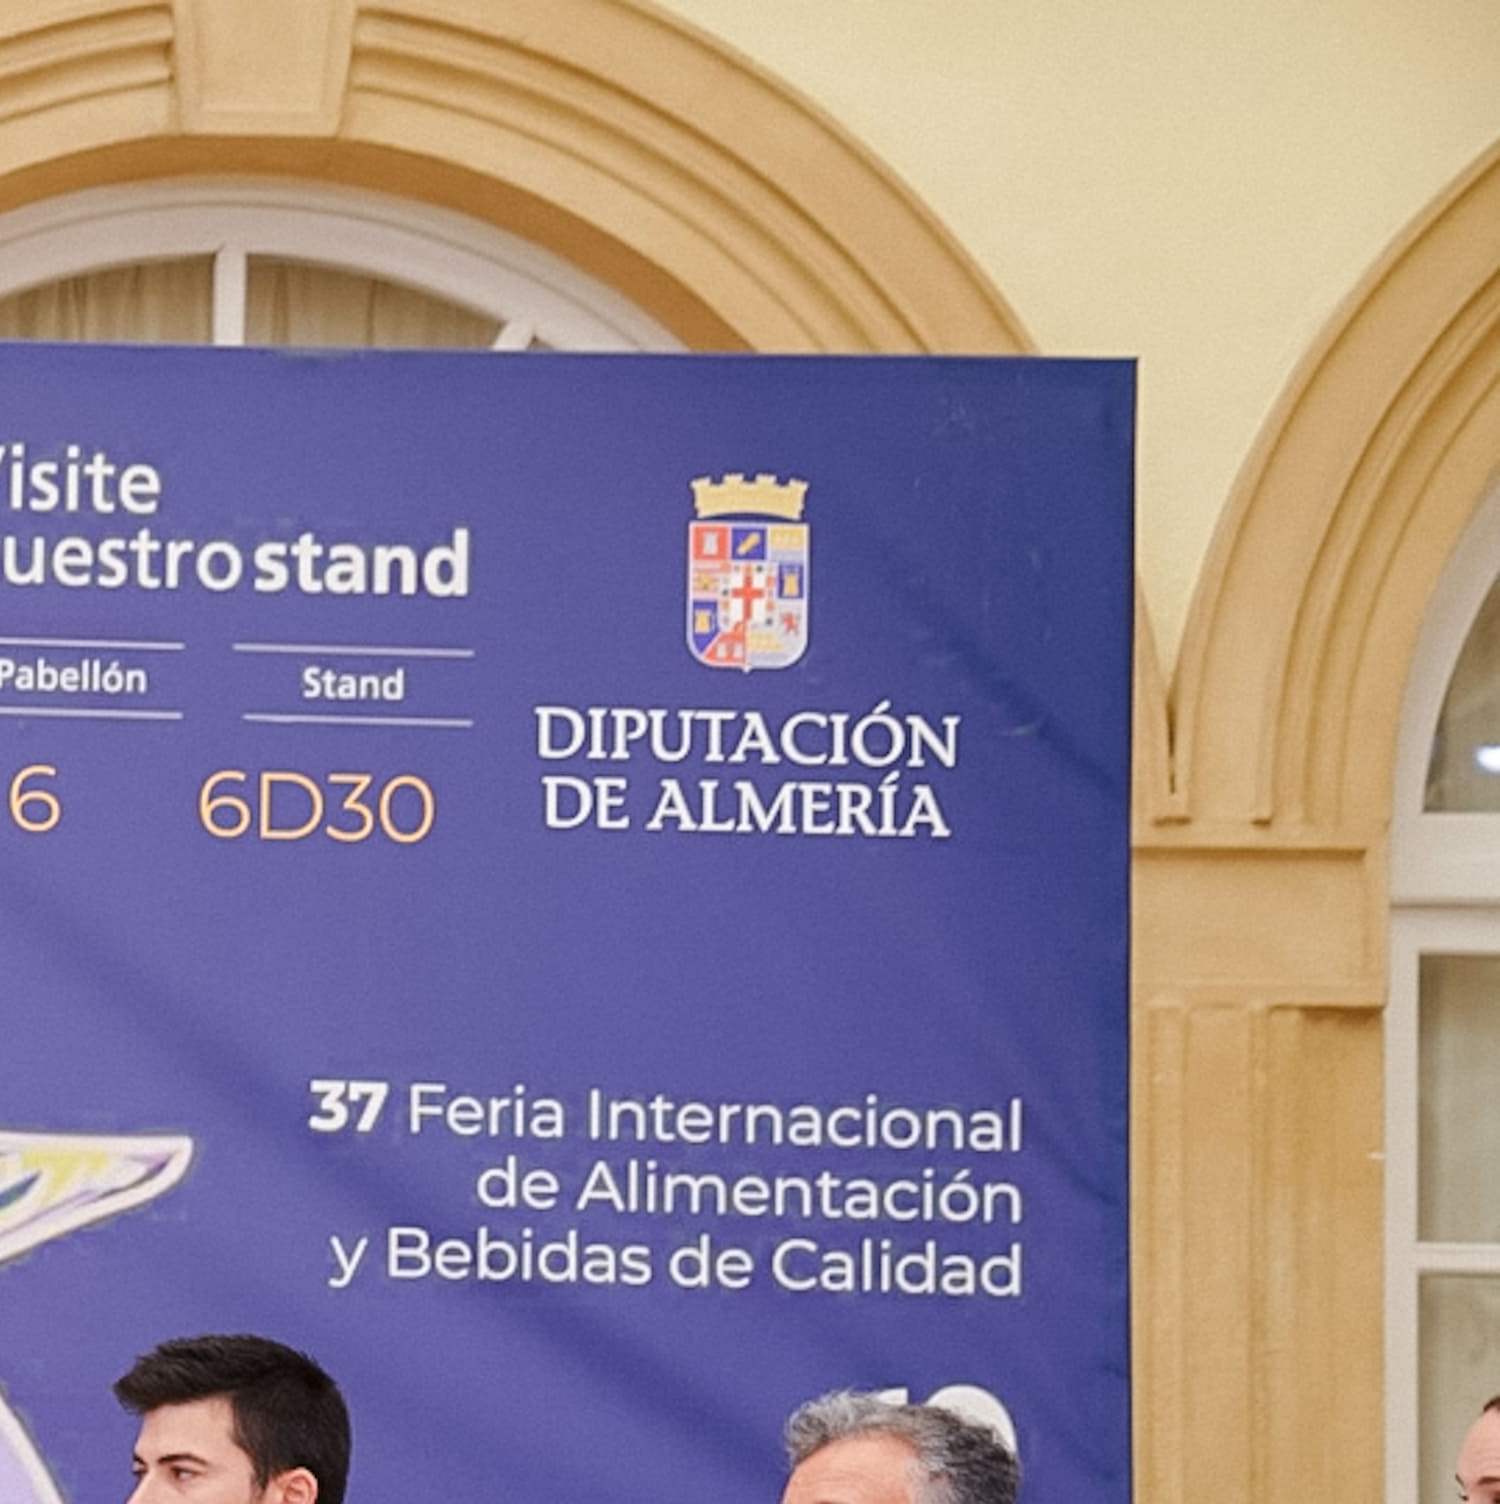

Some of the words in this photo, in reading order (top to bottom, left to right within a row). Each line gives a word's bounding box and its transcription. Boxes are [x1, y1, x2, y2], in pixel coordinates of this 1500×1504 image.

[254, 528, 470, 597] stand
[302, 665, 405, 701] Stand
[534, 699, 960, 768] DIPUTACIÓN
[8, 764, 61, 833] 6
[199, 769, 435, 844] 6D30
[541, 775, 630, 830] DE
[645, 770, 952, 837] ALMERÍA
[308, 1079, 389, 1133] 37
[410, 1084, 565, 1139] Feria
[588, 1089, 1024, 1152] Internacional
[476, 1155, 560, 1209] de
[576, 1161, 1024, 1224] Alimentación
[329, 1236, 368, 1289] y
[388, 1226, 653, 1286] Bebidas
[669, 1235, 754, 1291] de
[772, 1240, 1024, 1297] Calidad
